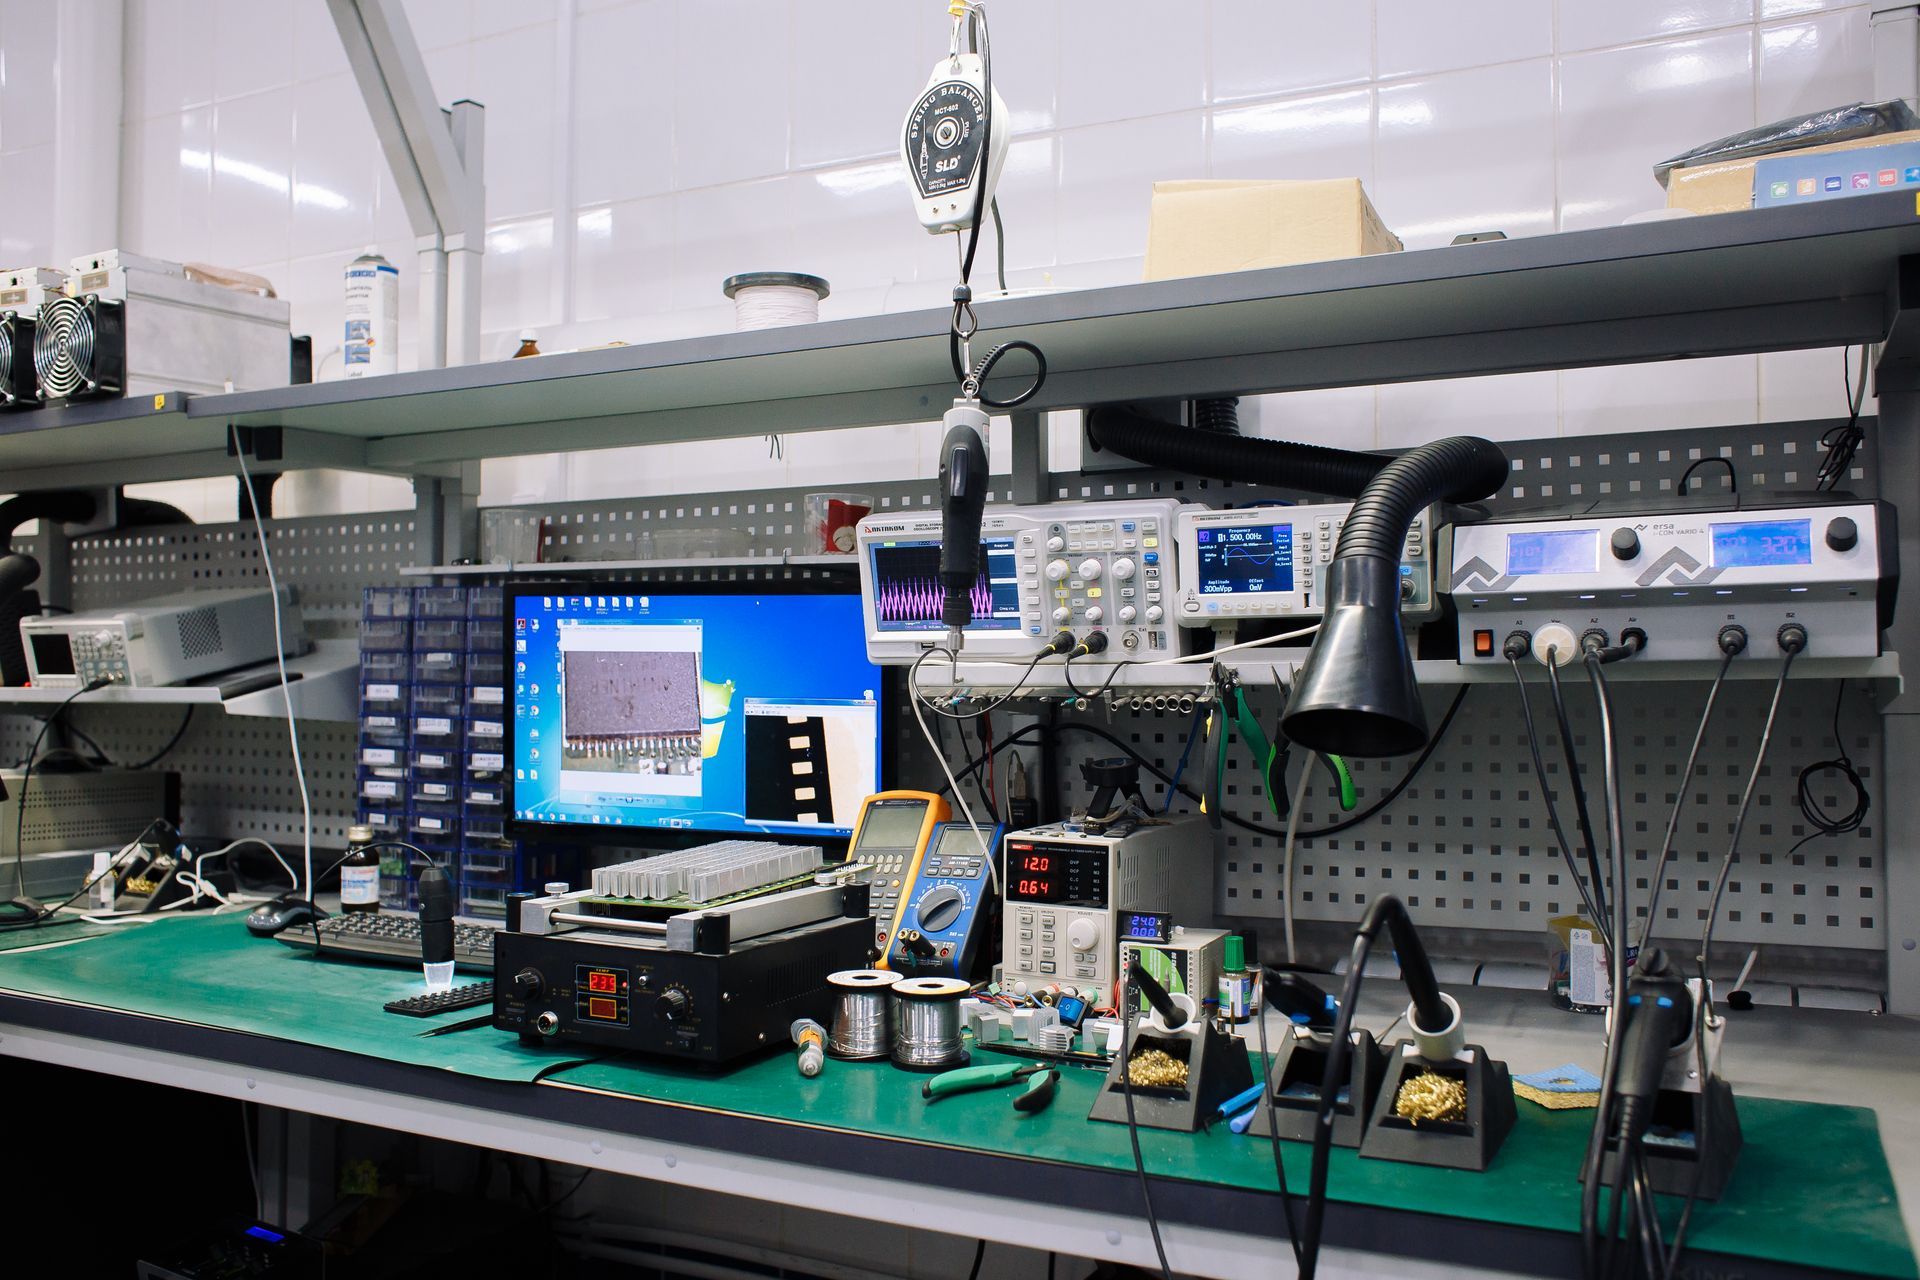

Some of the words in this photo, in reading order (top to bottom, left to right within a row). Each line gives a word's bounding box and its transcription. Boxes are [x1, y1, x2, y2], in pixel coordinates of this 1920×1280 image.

[911, 95, 936, 139] SPRING
[941, 86, 983, 123] BALANCER
[935, 157, 959, 173] SLD
[1204, 585, 1233, 593] 300mVpp
[1249, 583, 1263, 591] 0mV
[1024, 857, 1049, 871] 12.0
[1019, 880, 1049, 895] 0.64
